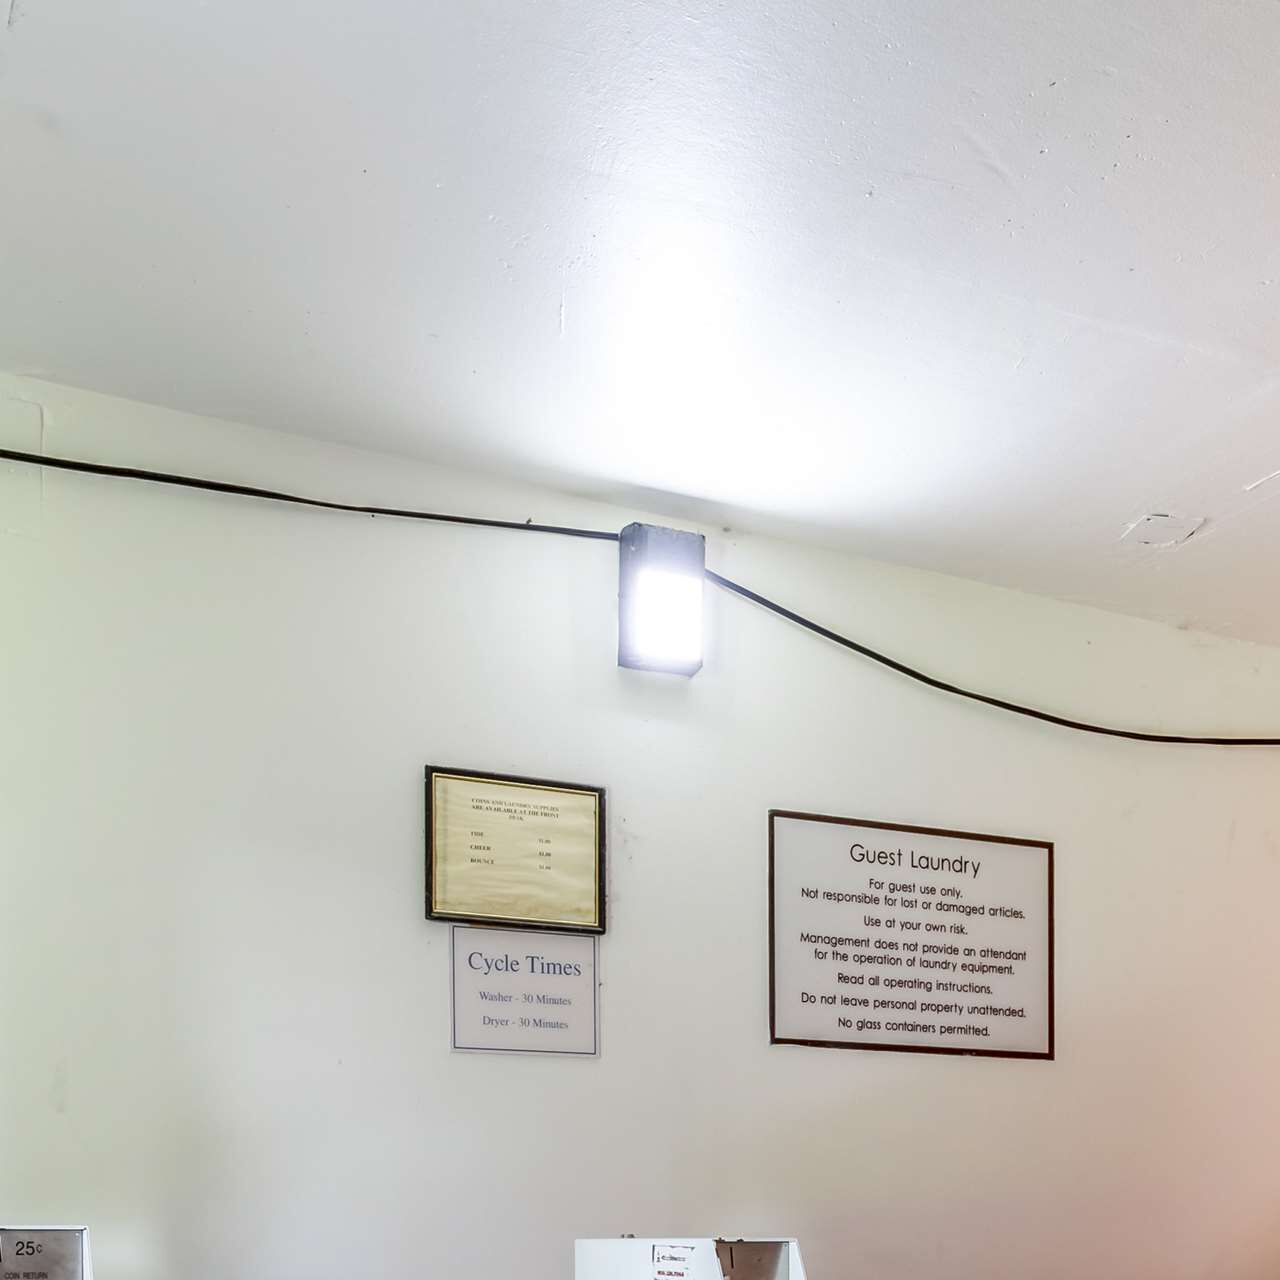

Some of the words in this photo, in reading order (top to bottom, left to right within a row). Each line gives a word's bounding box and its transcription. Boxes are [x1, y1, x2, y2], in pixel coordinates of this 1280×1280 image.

[485, 806, 518, 814] AVAILABLE
[540, 811, 559, 819] FRONT
[470, 857, 495, 865] BOUNCE
[850, 844, 903, 867] Guest
[911, 850, 981, 879] Laundry
[869, 878, 885, 890] For
[888, 881, 916, 893] guest
[920, 885, 937, 896] use
[940, 886, 963, 899] only.
[801, 888, 819, 899] Not
[823, 889, 880, 905] responsible
[884, 896, 897, 907] for
[901, 897, 918, 909] lost
[922, 900, 932, 910] or
[936, 900, 985, 917] damaged
[988, 906, 1026, 920] articles.
[863, 916, 881, 927] Use
[885, 918, 896, 928] at
[899, 921, 922, 932] your
[925, 923, 947, 933] own
[950, 923, 969, 935] risk.
[800, 933, 871, 948] Management
[874, 939, 899, 951] does
[902, 942, 919, 952] not
[922, 944, 960, 956] provide
[963, 948, 977, 957] an
[980, 948, 1028, 961] attendant
[468, 951, 520, 975] Cycle
[525, 955, 582, 977] Times
[814, 948, 829, 960] for
[832, 950, 850, 962] the
[853, 953, 903, 966] operation
[906, 956, 917, 967] of
[919, 958, 957, 973] laundry
[961, 962, 1016, 975] equipment.
[837, 973, 865, 985] Read
[868, 975, 880, 986] all
[883, 977, 933, 993] operating
[936, 980, 993, 995] instructions.
[479, 990, 512, 1003] Washer
[521, 993, 534, 1004] 30
[536, 994, 573, 1006] Minutes
[801, 992, 816, 1004] Do
[820, 994, 836, 1005] not
[841, 995, 869, 1008] leave
[873, 998, 917, 1011] personal
[920, 1002, 963, 1015] property
[967, 1004, 1027, 1018] unattended.
[482, 1015, 510, 1028] Dryer
[519, 1016, 530, 1028] 30
[532, 1018, 569, 1030] Minutes
[837, 1017, 853, 1028] No
[856, 1018, 882, 1031] glass
[885, 1021, 937, 1034] containers
[940, 1024, 991, 1038] permitted.
[4, 1271, 21, 1280] COIN
[22, 1271, 49, 1280] RETURN
